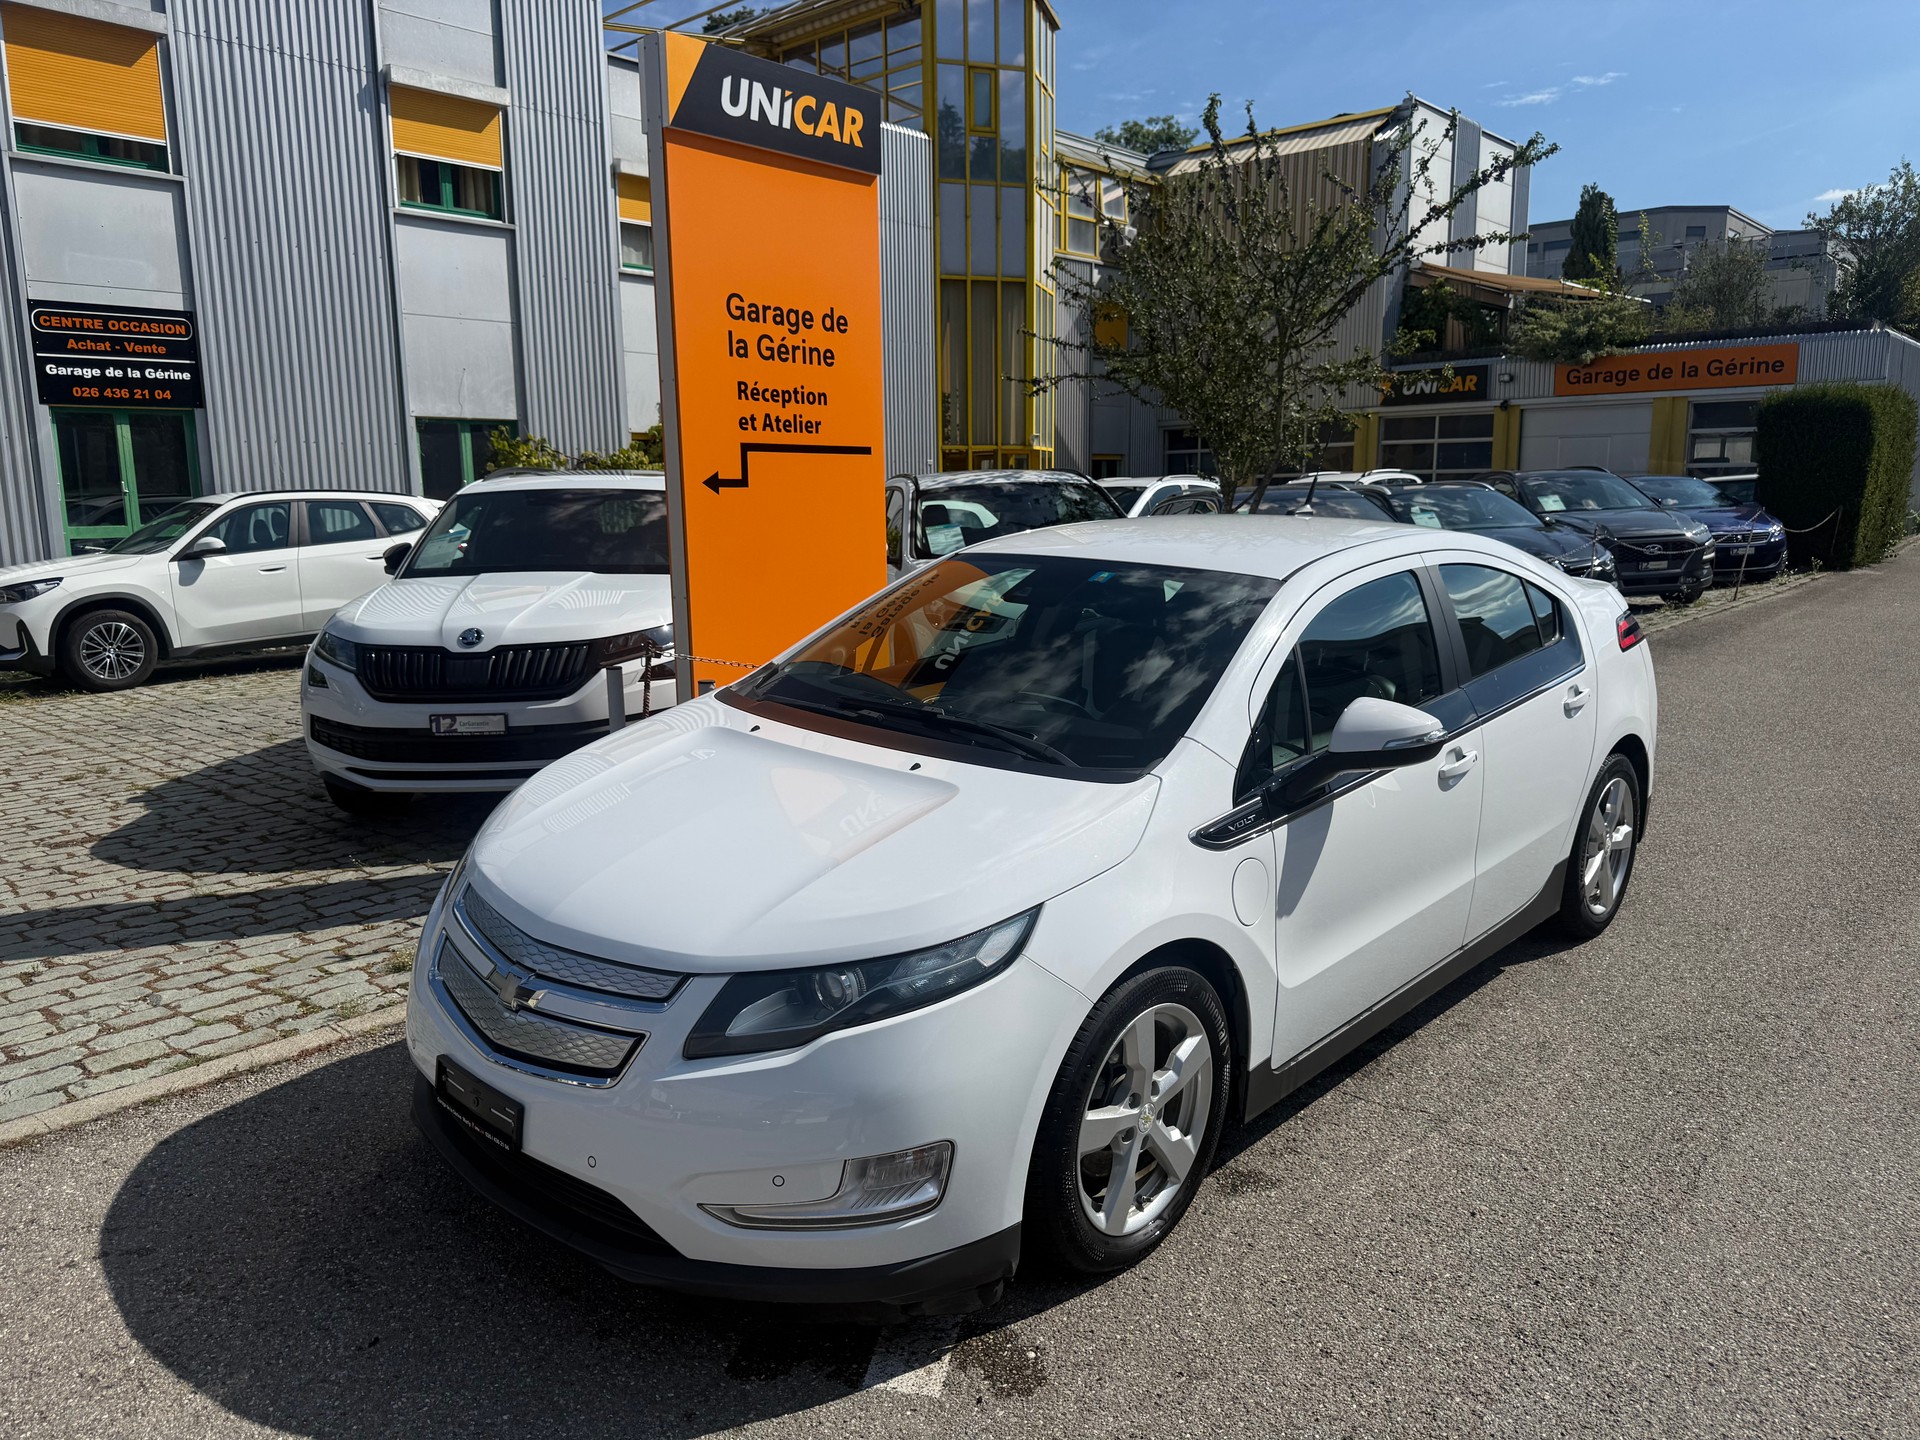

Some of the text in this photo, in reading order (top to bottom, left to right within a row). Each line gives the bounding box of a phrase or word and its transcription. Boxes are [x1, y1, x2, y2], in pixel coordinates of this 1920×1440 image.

[726, 292, 849, 334] Garage de
[39, 315, 186, 335] CENTRE OCCASION
[66, 338, 112, 352] Achat
[123, 341, 167, 355] Vente
[727, 329, 836, 368] la Gérine
[45, 363, 192, 381] Garage de la Gérine
[1566, 356, 1785, 387] Garage de la Gérine
[72, 386, 172, 400] 026 436 21 04
[737, 381, 828, 409] Réception
[738, 413, 822, 435] et Atelier
[1227, 814, 1256, 831] VOLT
